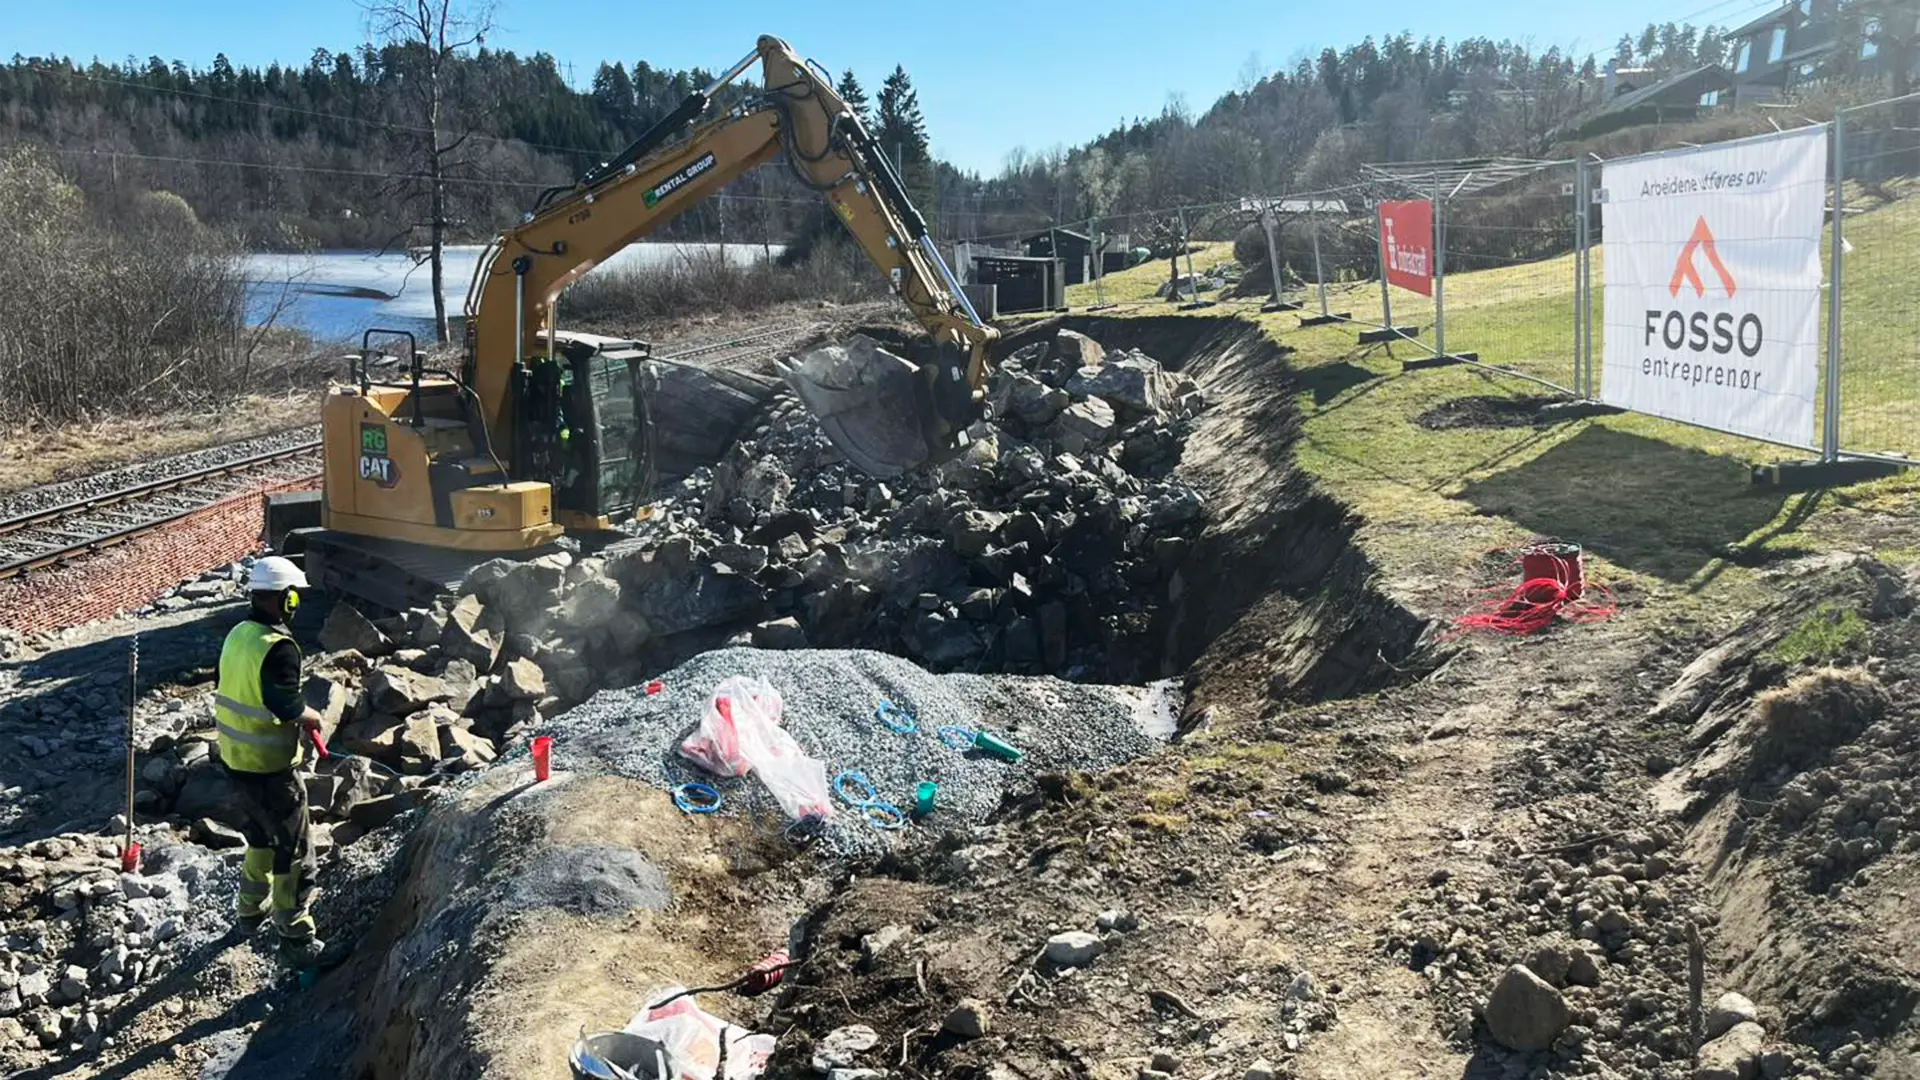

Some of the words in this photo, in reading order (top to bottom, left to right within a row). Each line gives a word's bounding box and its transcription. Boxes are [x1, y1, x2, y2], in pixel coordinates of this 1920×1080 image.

[654, 173, 687, 199] RENTAL
[686, 154, 714, 178] GROUP
[1640, 176, 1698, 197] Arbeidene
[1645, 310, 1763, 358] FOSSO
[1642, 357, 1762, 391] entreprenør
[362, 429, 386, 450] RG
[360, 456, 390, 481] CAT
